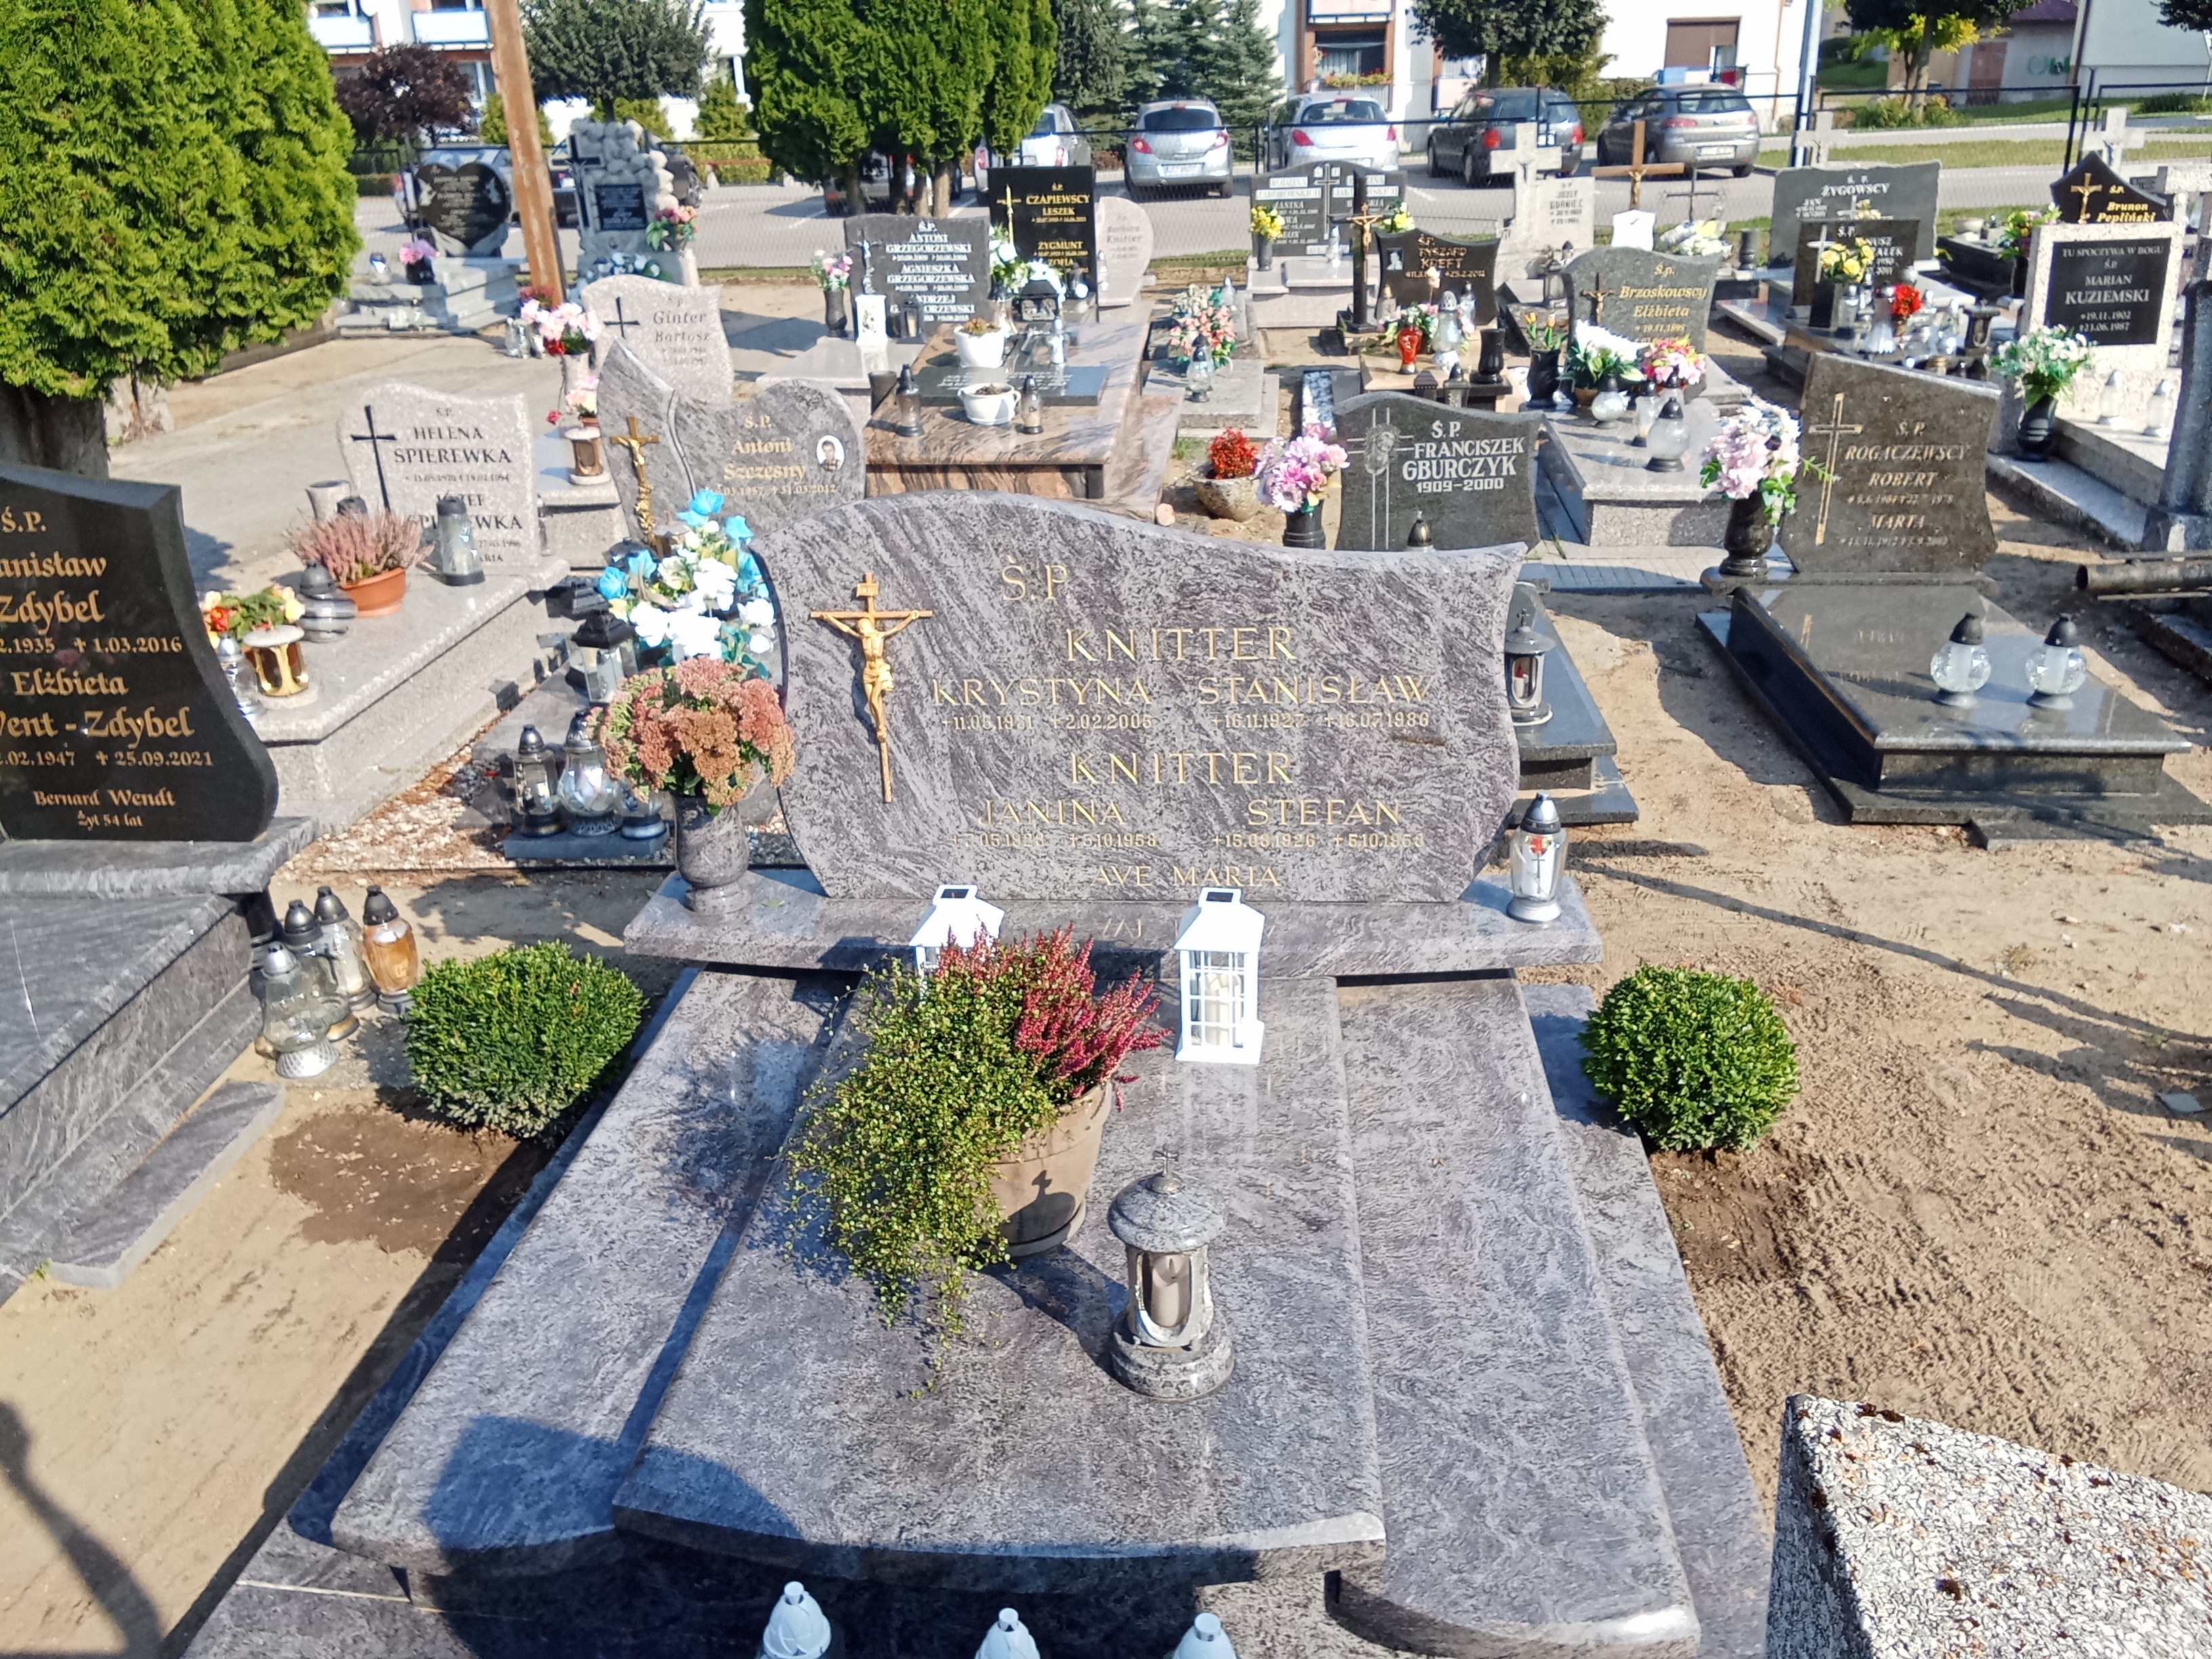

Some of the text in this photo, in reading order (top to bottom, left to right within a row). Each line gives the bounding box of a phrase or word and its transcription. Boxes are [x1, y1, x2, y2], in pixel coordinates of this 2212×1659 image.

[1025, 193, 1090, 205] CZAPIEWSCY
[2106, 201, 2148, 212] Brunon
[1042, 206, 1076, 216] LESZEK
[909, 232, 949, 243] ANTONI
[885, 242, 972, 254] GRZEGORZEWSKI
[1038, 241, 1084, 250] ZYGMUNT
[2076, 247, 2125, 258] SPOCZYWA
[2137, 245, 2164, 255] BOGU
[901, 263, 960, 274] AGNIESZKA
[886, 272, 976, 284] GRZEGORZEWSKA
[2085, 274, 2133, 287] MARIAN
[1618, 285, 1708, 300] Brzoskowscy
[2065, 289, 2150, 305] KUZIEMSKI
[653, 310, 707, 325] Ginter
[1633, 304, 1691, 318] Elżbieta
[655, 331, 710, 342] Bartosz
[413, 426, 484, 441] HELENA
[731, 436, 794, 455] Antoni
[1414, 436, 1525, 459] FRANCISZEK
[1402, 455, 1517, 481] GBURCZYK
[1868, 472, 1939, 487] ROBERT
[1, 506, 47, 533] Ś.P.
[0, 590, 105, 636] Zdybel
[1066, 627, 1298, 662] KNITTER
[10, 668, 129, 696] Elżbieta
[932, 676, 1435, 707] KRYSTYNA STANISŁAW
[85, 705, 195, 749] Zdybel
[115, 750, 214, 766] 25.09.2021
[1071, 752, 1294, 785] KNITTER
[33, 787, 177, 807] Bernard Wendt
[123, 812, 144, 827] lat
[977, 799, 1402, 826] JANINA STEFAN
[1093, 865, 1282, 887] AVE MARIA
